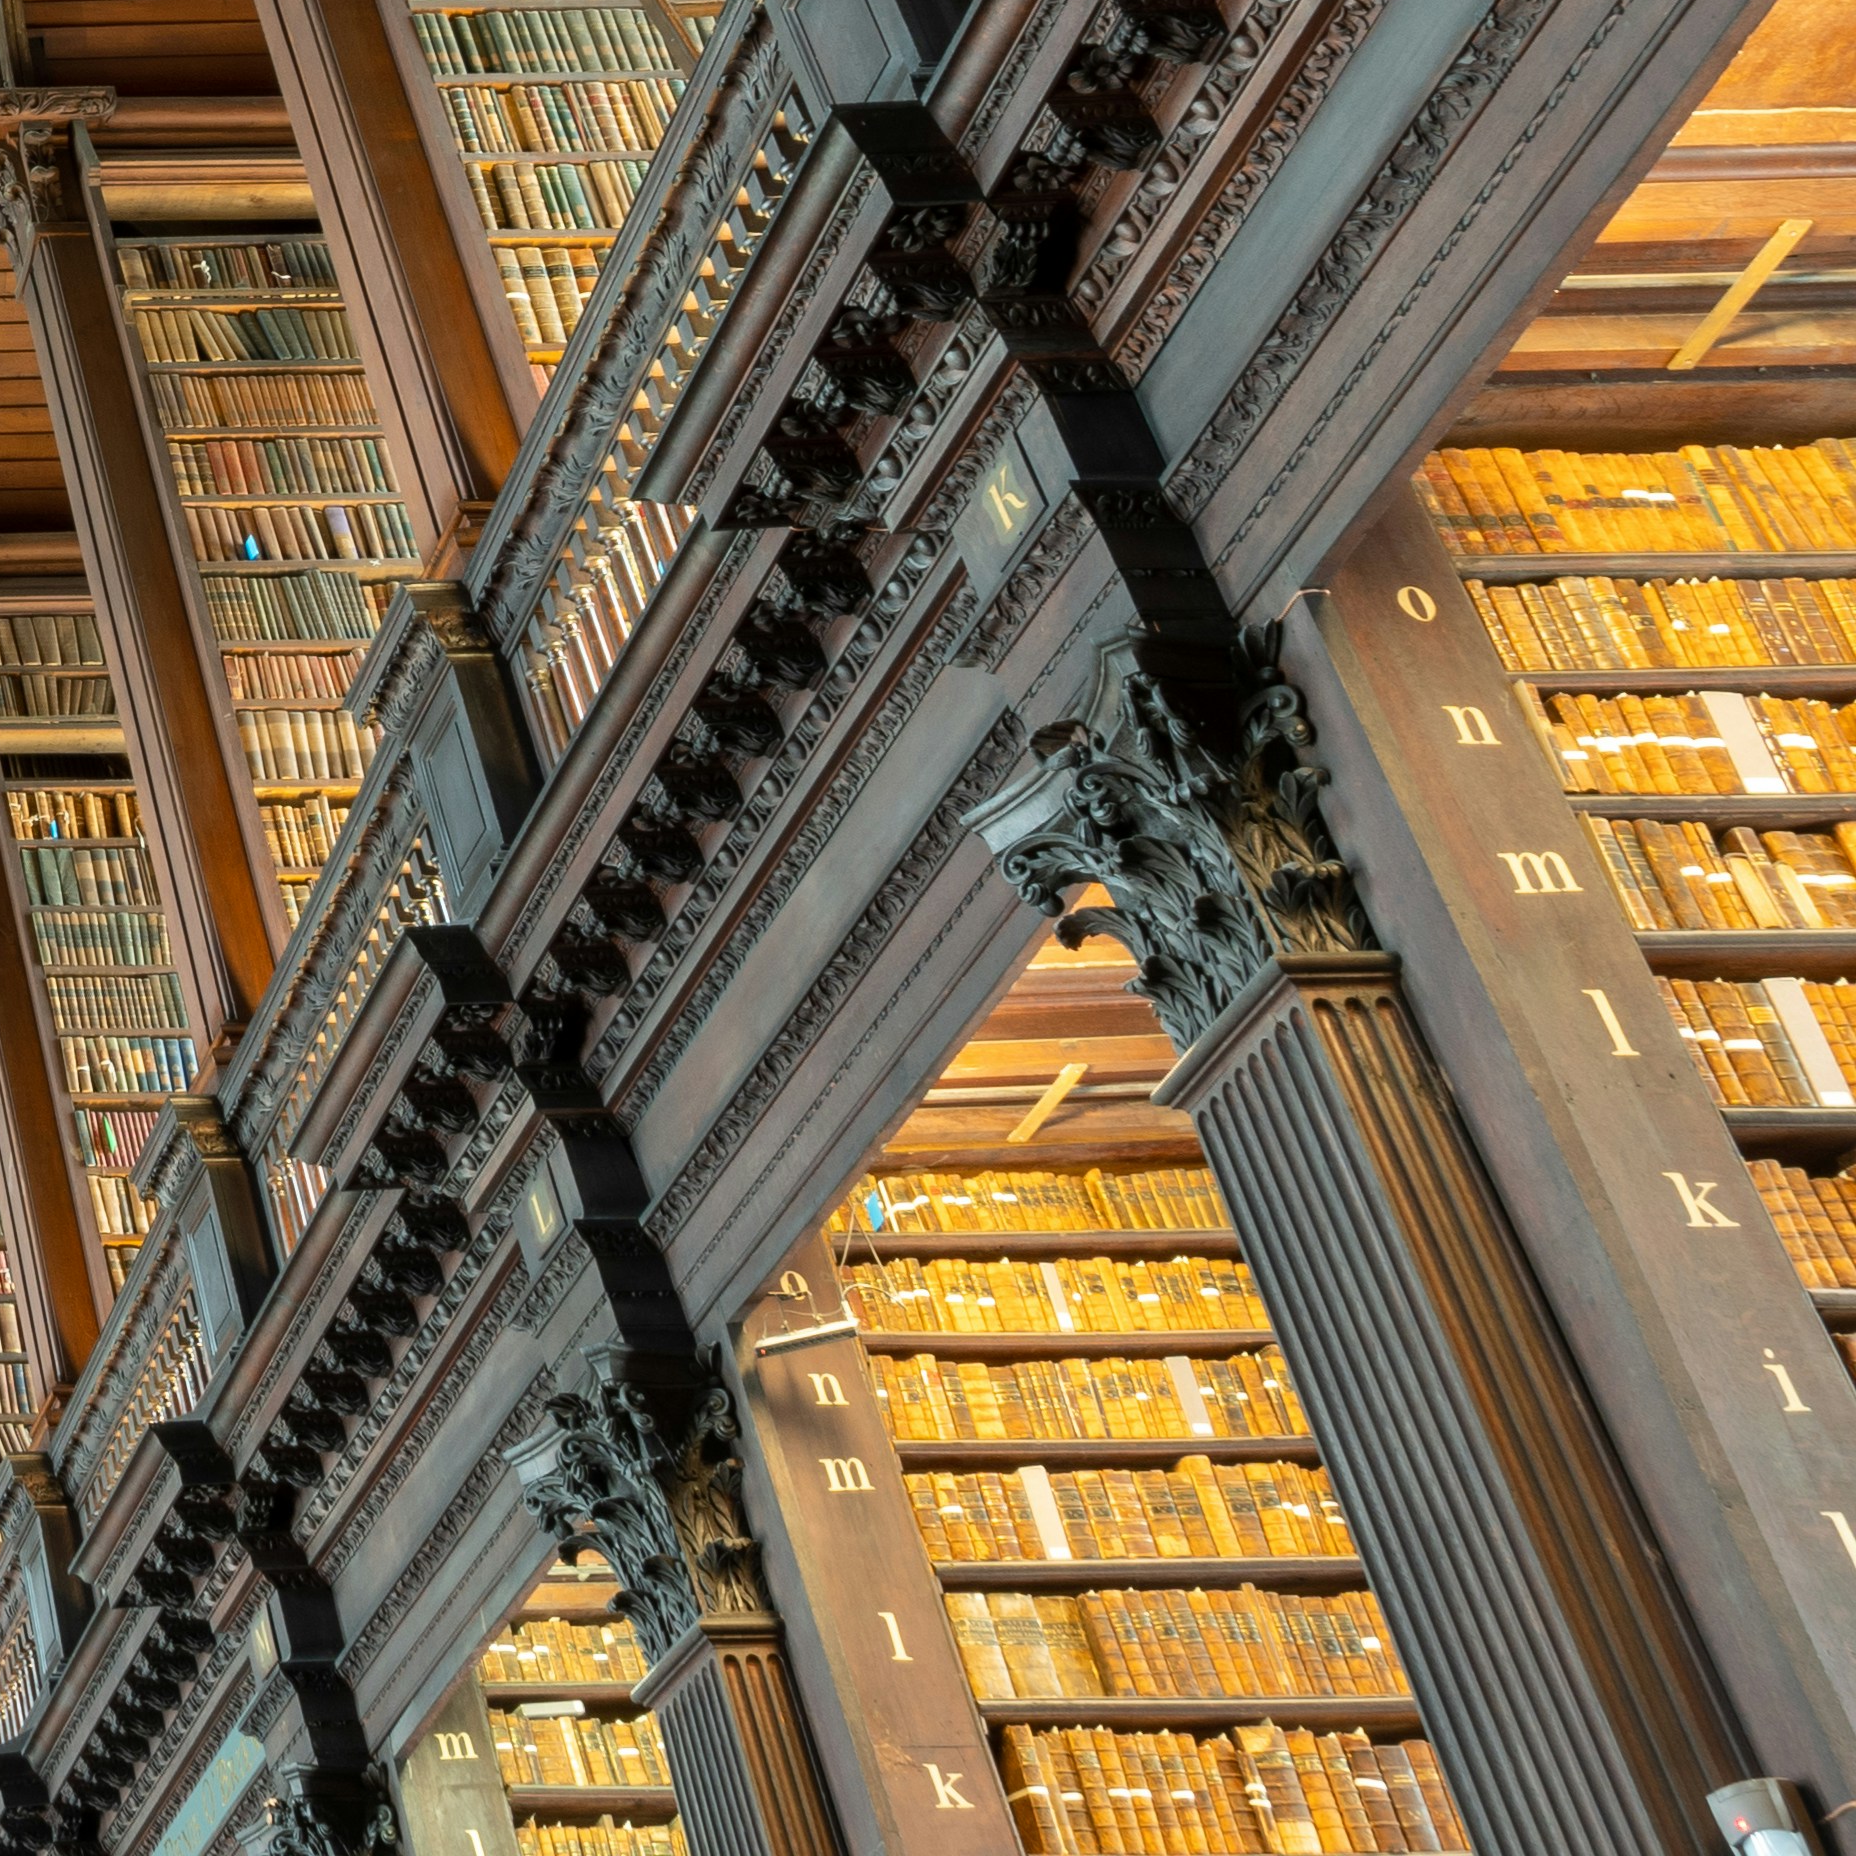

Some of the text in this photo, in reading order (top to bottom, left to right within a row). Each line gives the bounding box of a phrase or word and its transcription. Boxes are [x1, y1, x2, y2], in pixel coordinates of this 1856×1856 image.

[988, 465, 1028, 531] K
[1397, 586, 1438, 624] o
[1442, 704, 1503, 746] n
[1497, 850, 1585, 894] m
[1662, 1171, 1741, 1229] k
[809, 1370, 851, 1407] n
[1763, 1347, 1812, 1413] i
[819, 1456, 876, 1493] m
[433, 1730, 480, 1761] m
[922, 1763, 975, 1811] k
